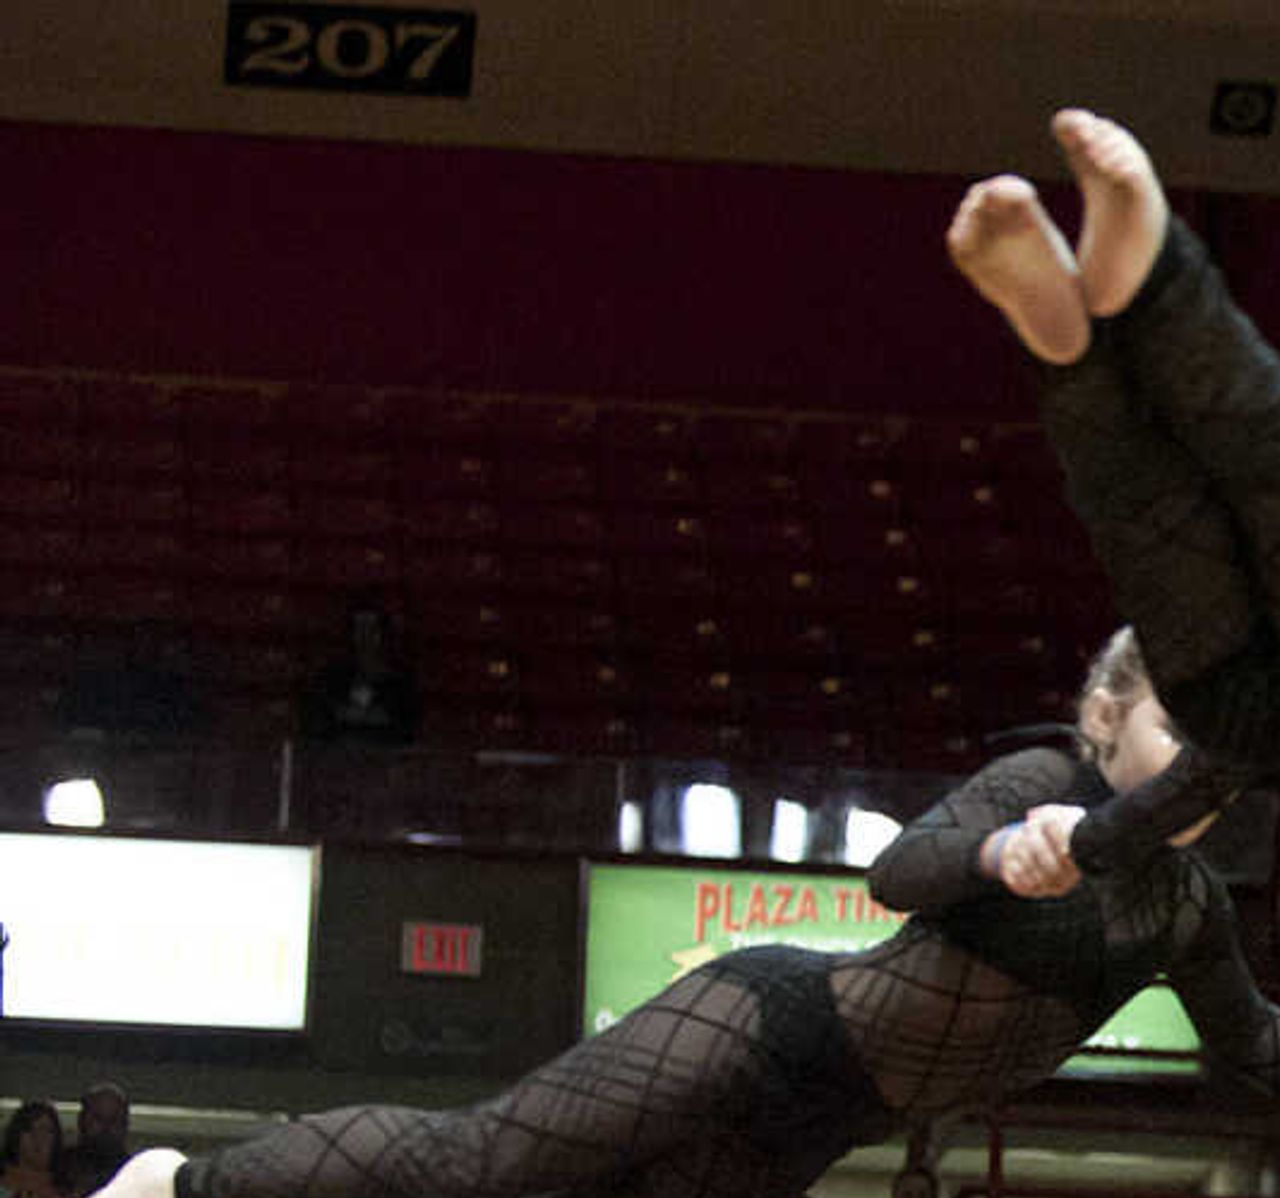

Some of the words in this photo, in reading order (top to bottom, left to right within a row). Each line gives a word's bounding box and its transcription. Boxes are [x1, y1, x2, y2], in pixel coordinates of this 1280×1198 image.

[239, 14, 462, 81] 207
[694, 882, 818, 942] PLAZA
[833, 886, 908, 922] TIR
[411, 921, 471, 973] EXIT
